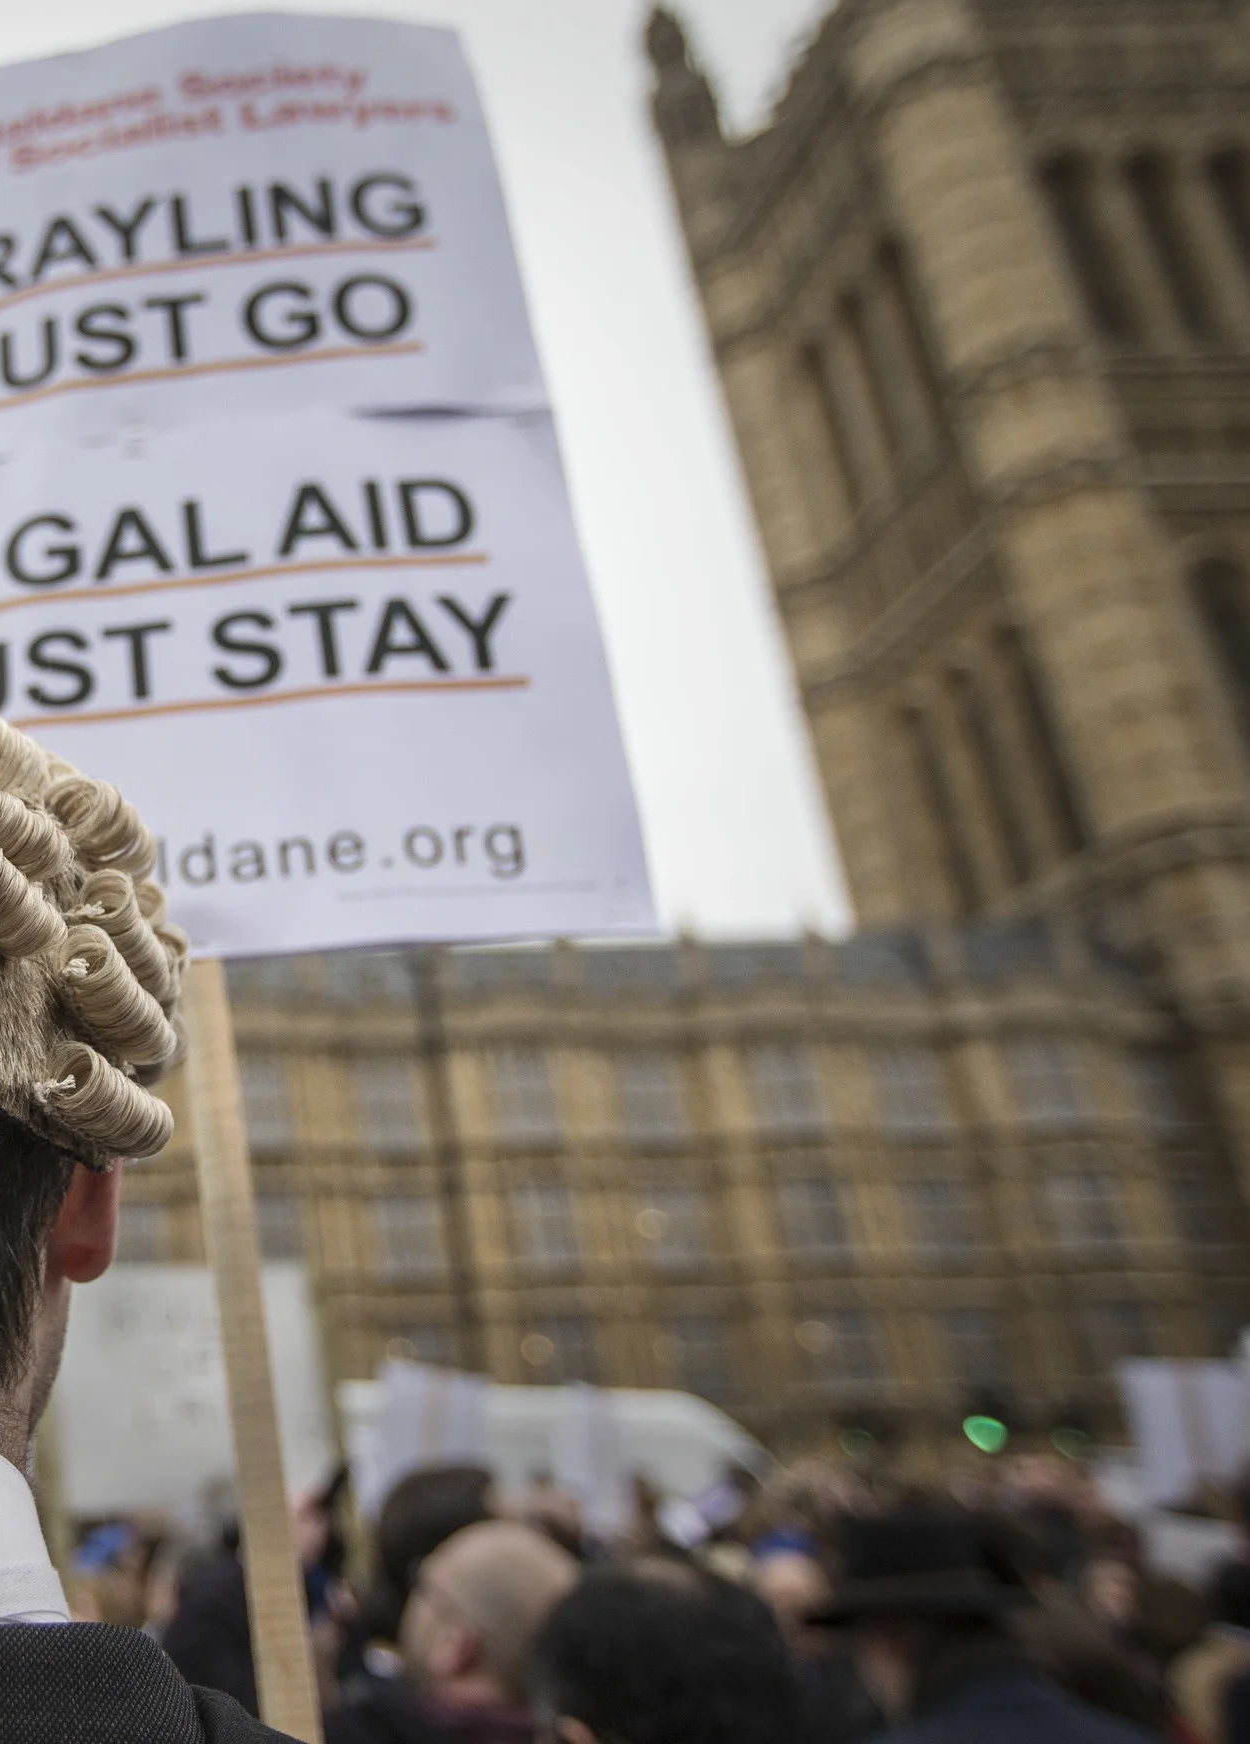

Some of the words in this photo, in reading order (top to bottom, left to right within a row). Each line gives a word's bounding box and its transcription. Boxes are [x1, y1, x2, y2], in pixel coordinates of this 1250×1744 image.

[179, 62, 368, 97] Society
[12, 108, 224, 172] Socialist
[241, 100, 456, 132] Lawyers
[242, 275, 413, 352] GO
[278, 477, 477, 560] AID
[211, 590, 513, 691] STAY
